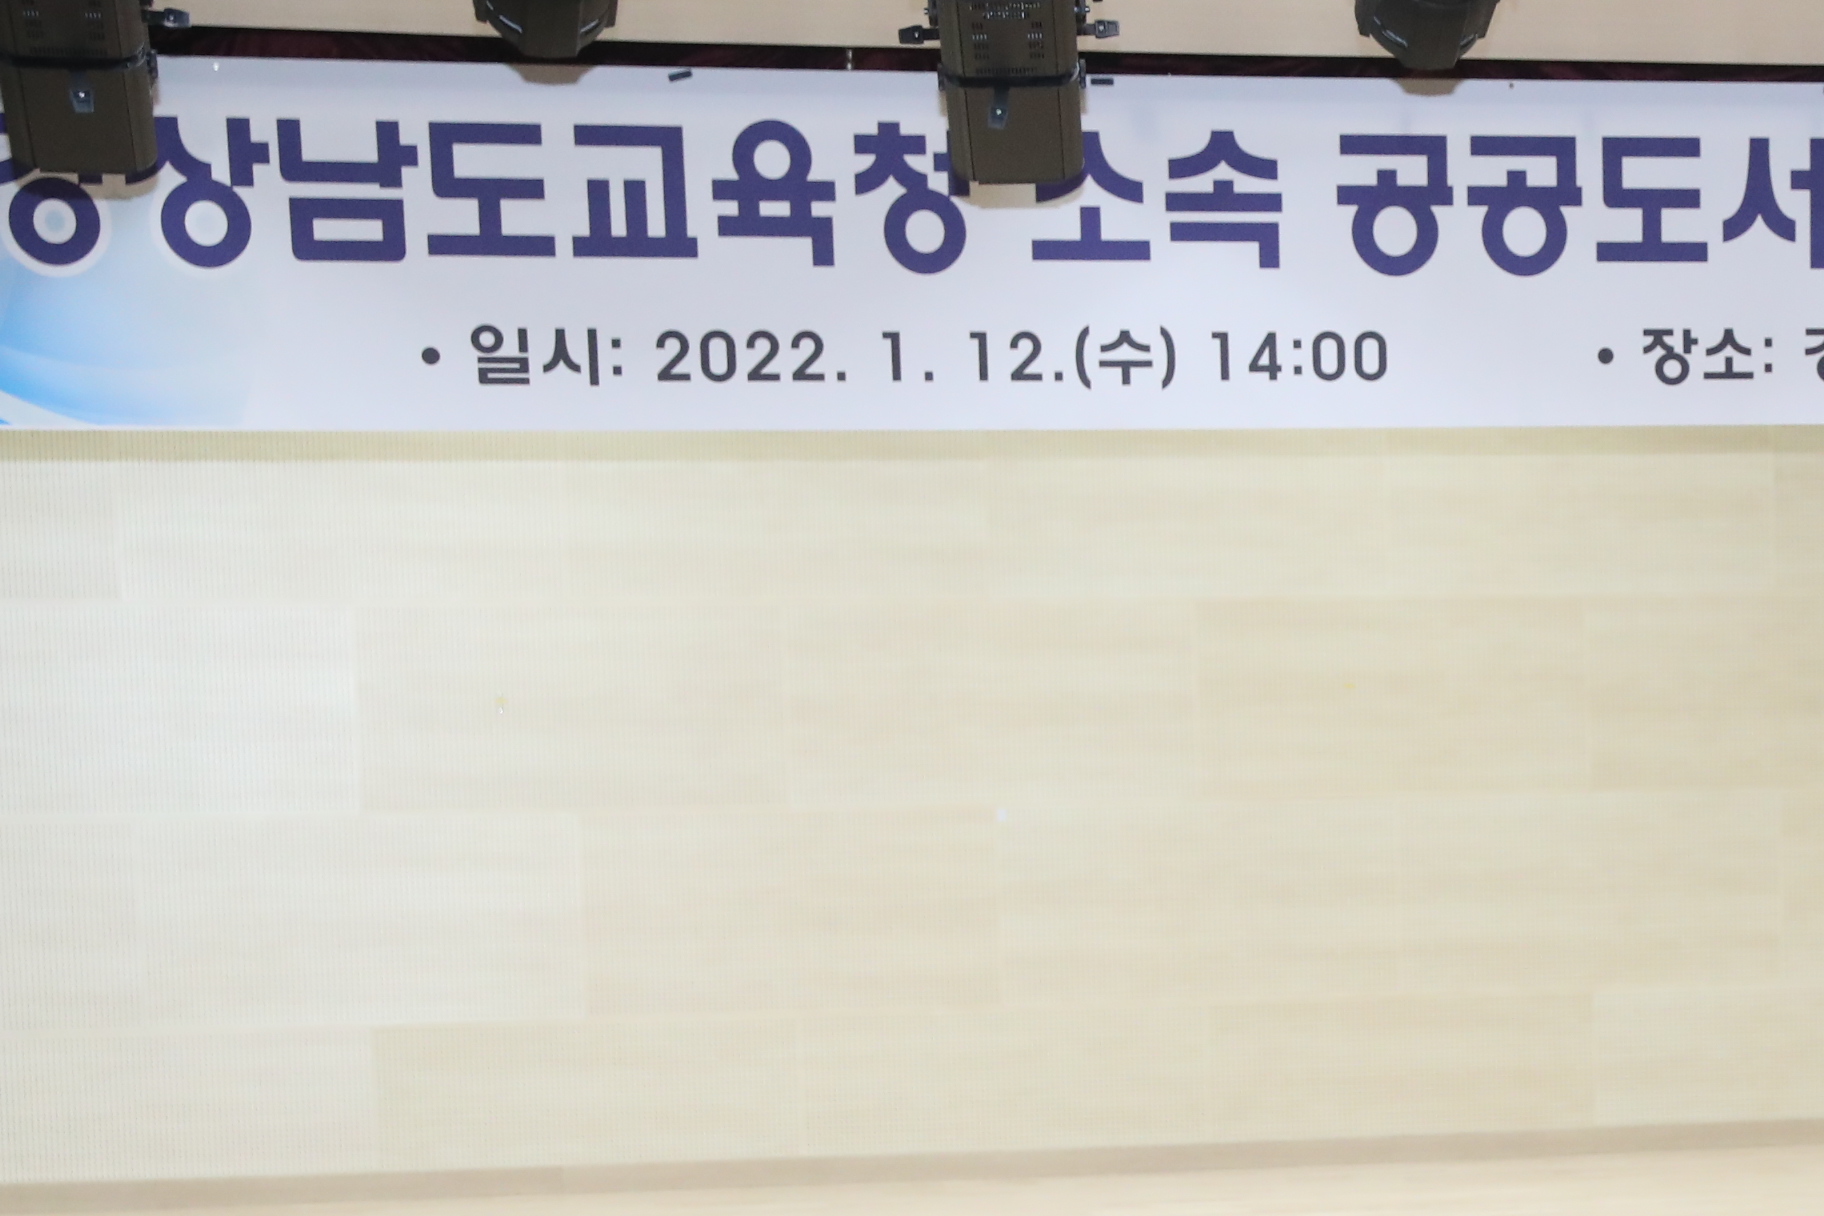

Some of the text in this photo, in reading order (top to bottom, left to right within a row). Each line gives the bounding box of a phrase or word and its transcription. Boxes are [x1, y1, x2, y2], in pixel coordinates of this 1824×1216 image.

[1032, 130, 1283, 269] 소속
[470, 324, 623, 387] 일시:
[655, 329, 846, 383] 2022.
[881, 331, 934, 382] 1.
[1211, 330, 1388, 382] 14:00
[1642, 328, 1773, 386] 장소:
